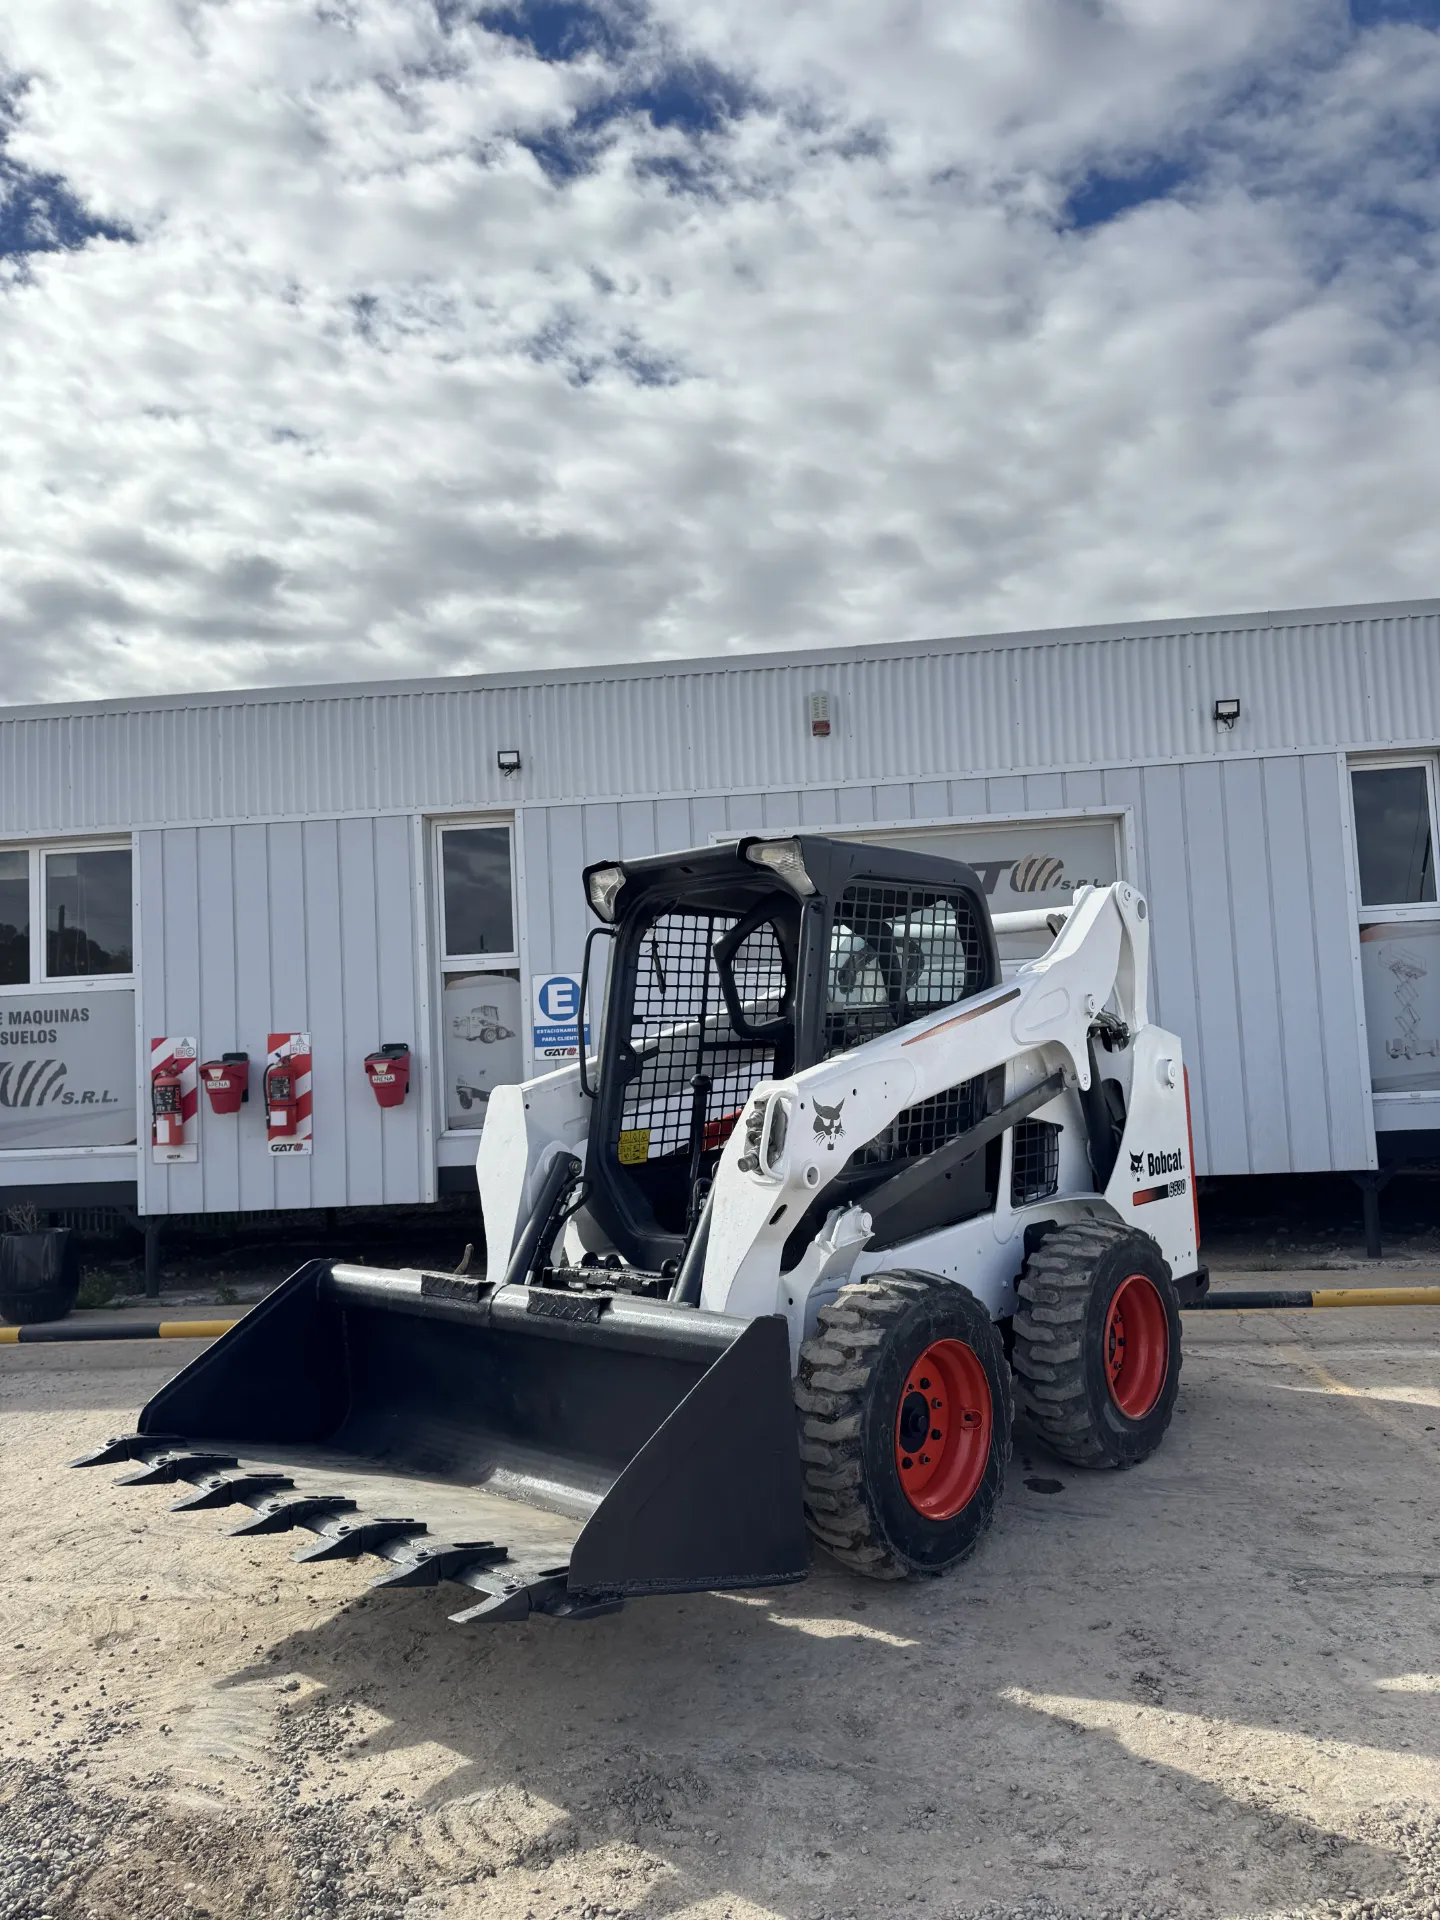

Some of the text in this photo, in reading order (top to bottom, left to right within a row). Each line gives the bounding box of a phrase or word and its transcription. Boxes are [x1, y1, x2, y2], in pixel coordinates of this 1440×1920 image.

[547, 983, 574, 1015] E
[8, 1007, 90, 1026] MAQUINAS
[0, 1029, 57, 1045] SUELOS
[61, 1089, 118, 1105] S.R.L.
[1147, 1147, 1182, 1177] Bobcat
[1168, 1178, 1186, 1198] S530
